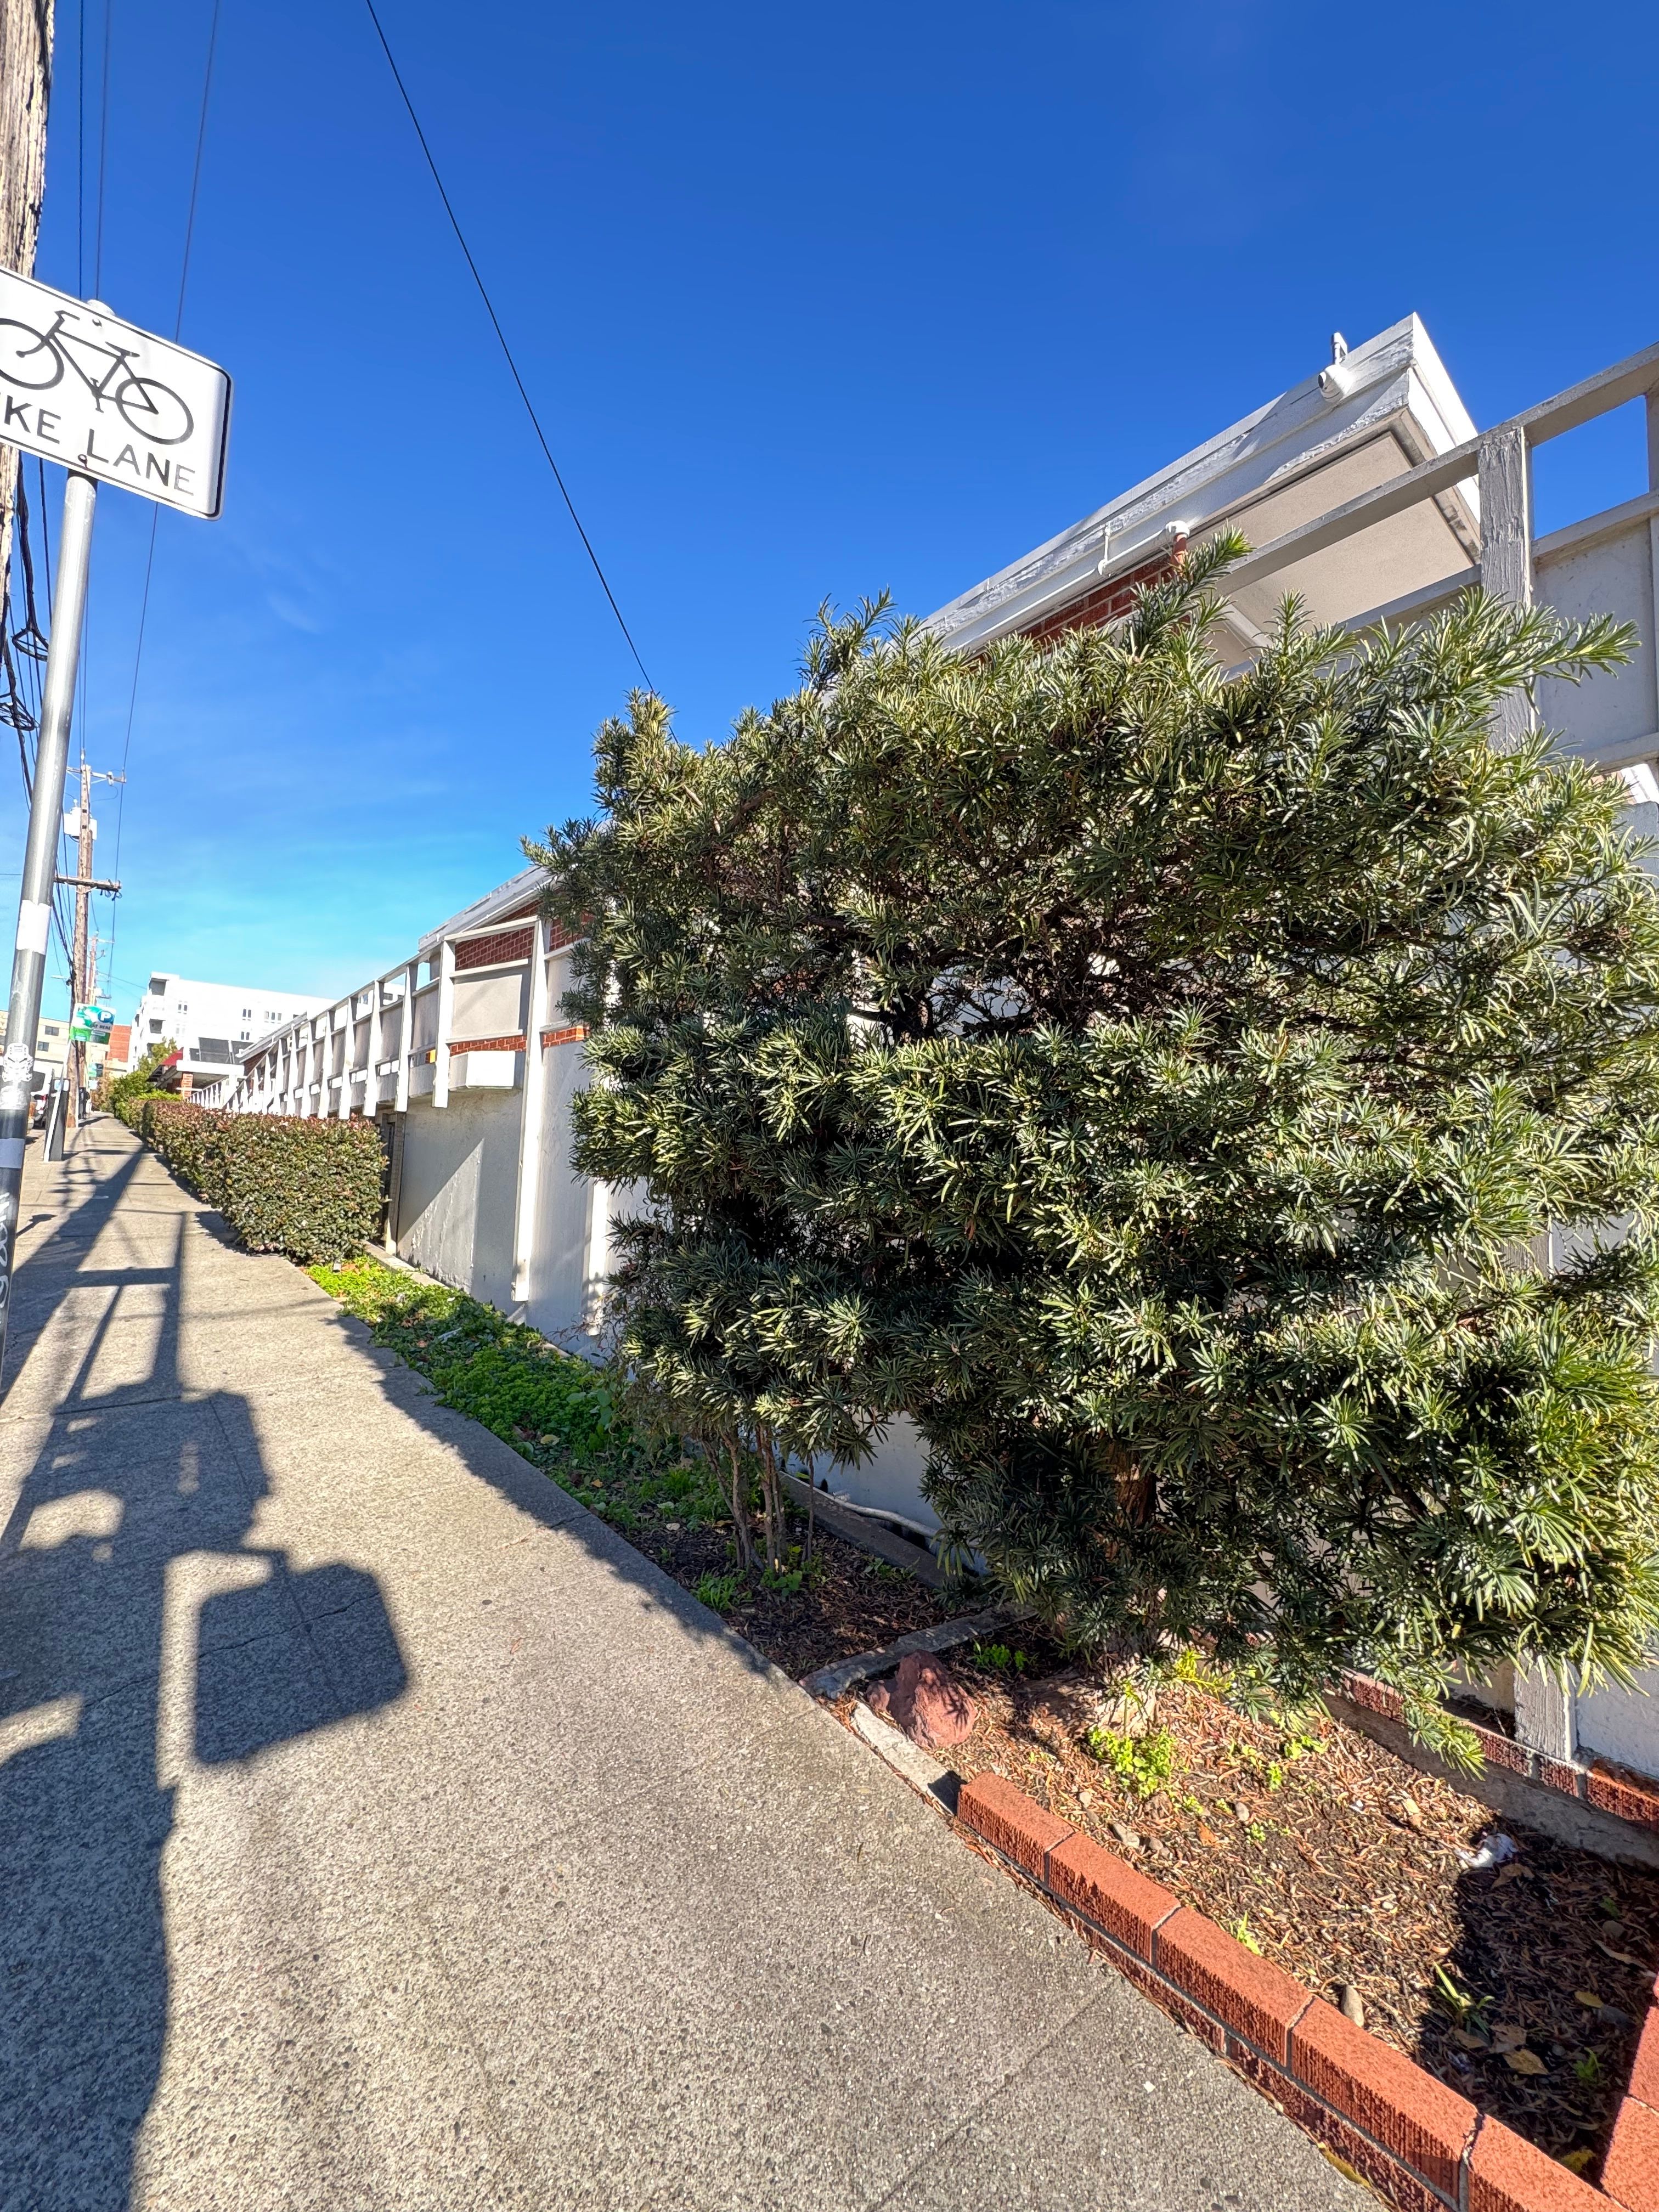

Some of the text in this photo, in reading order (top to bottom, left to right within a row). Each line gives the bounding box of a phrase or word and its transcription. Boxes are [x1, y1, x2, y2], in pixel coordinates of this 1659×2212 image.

[0, 392, 195, 496] KE LANE
[100, 1011, 111, 1021] P
